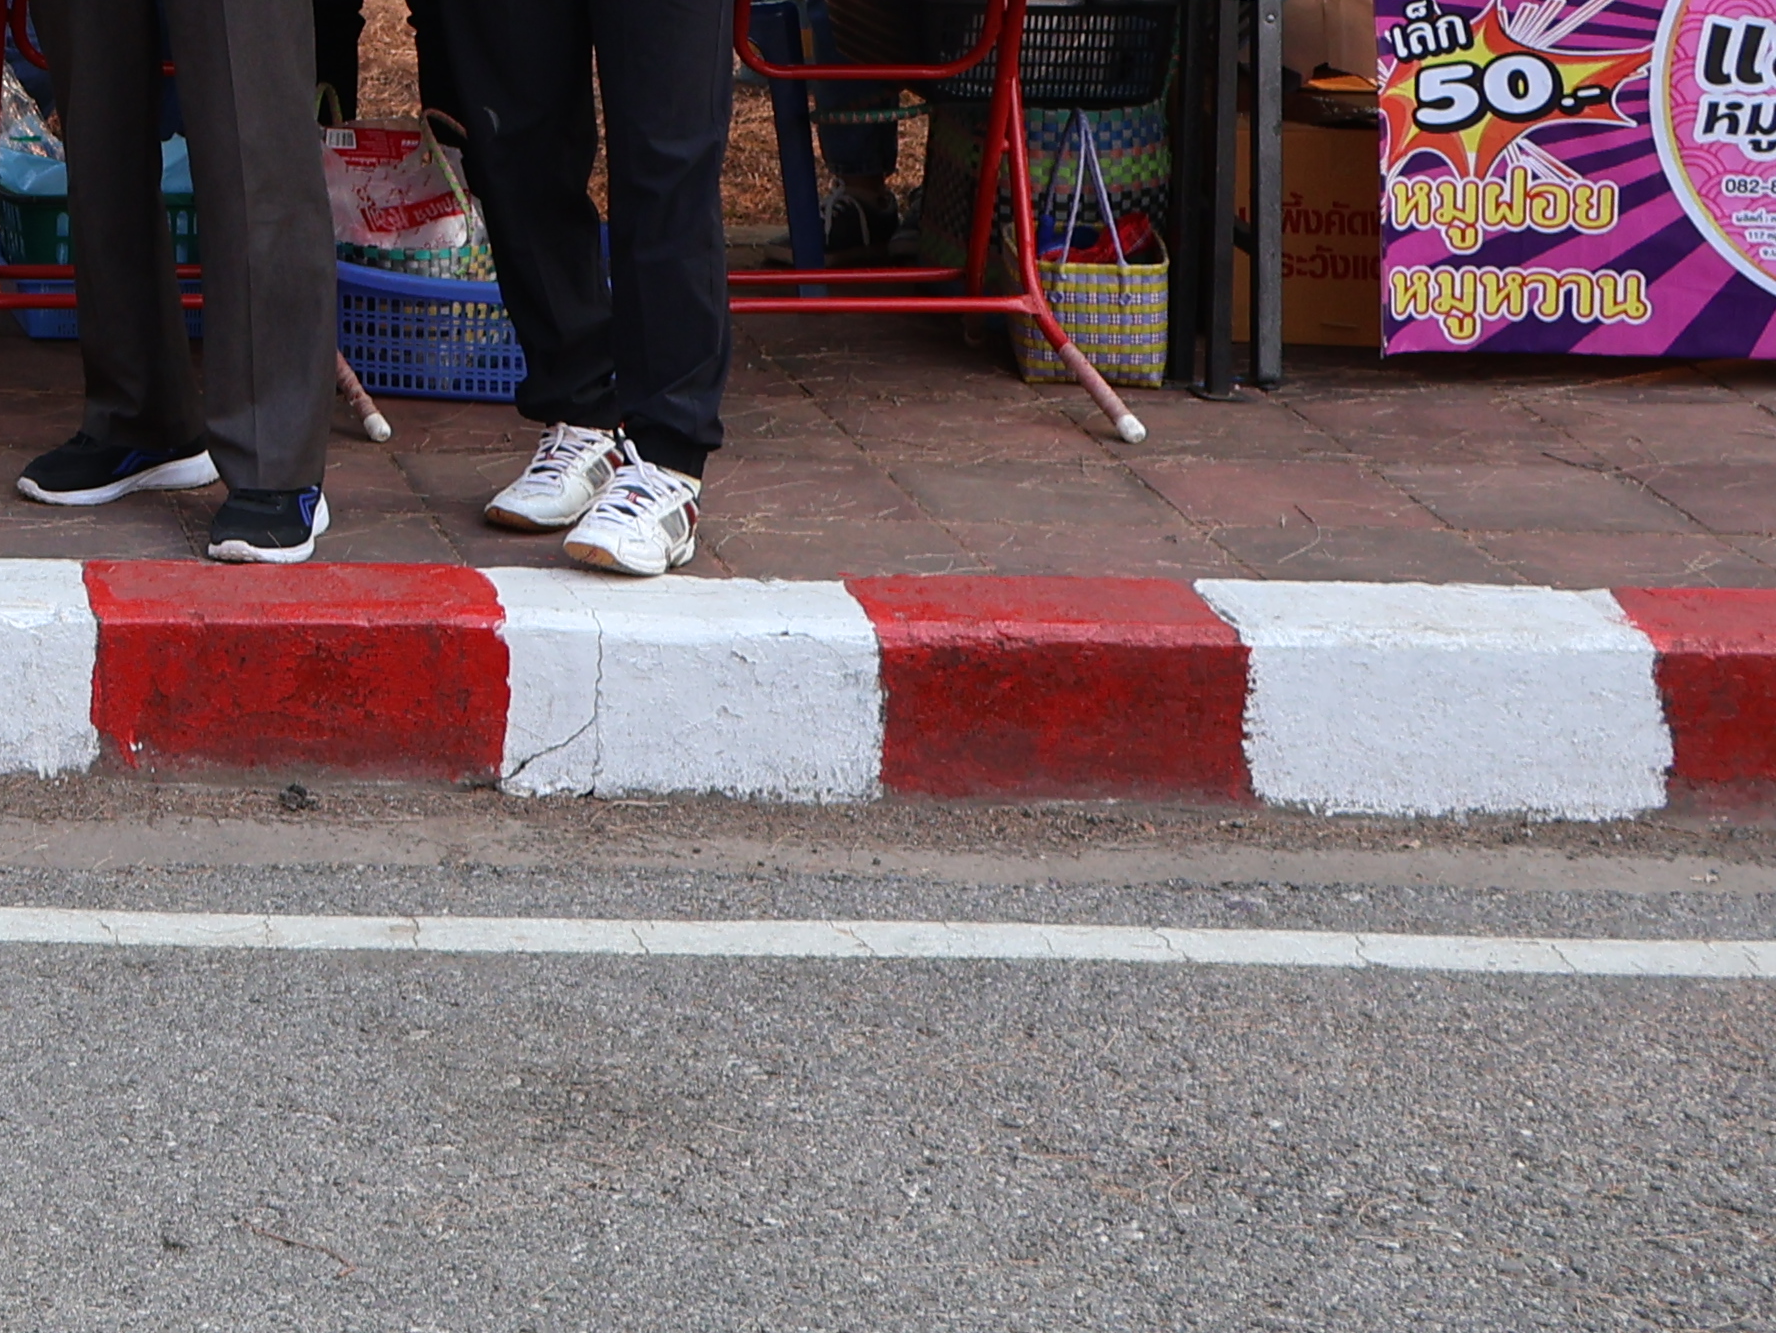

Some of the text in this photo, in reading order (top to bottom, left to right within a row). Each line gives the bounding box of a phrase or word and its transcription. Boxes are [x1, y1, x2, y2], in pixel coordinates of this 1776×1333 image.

[1392, 5, 1470, 60] เล็ก
[1392, 167, 1616, 252] หมูฝอย
[1391, 266, 1648, 342] หมูหวาน
